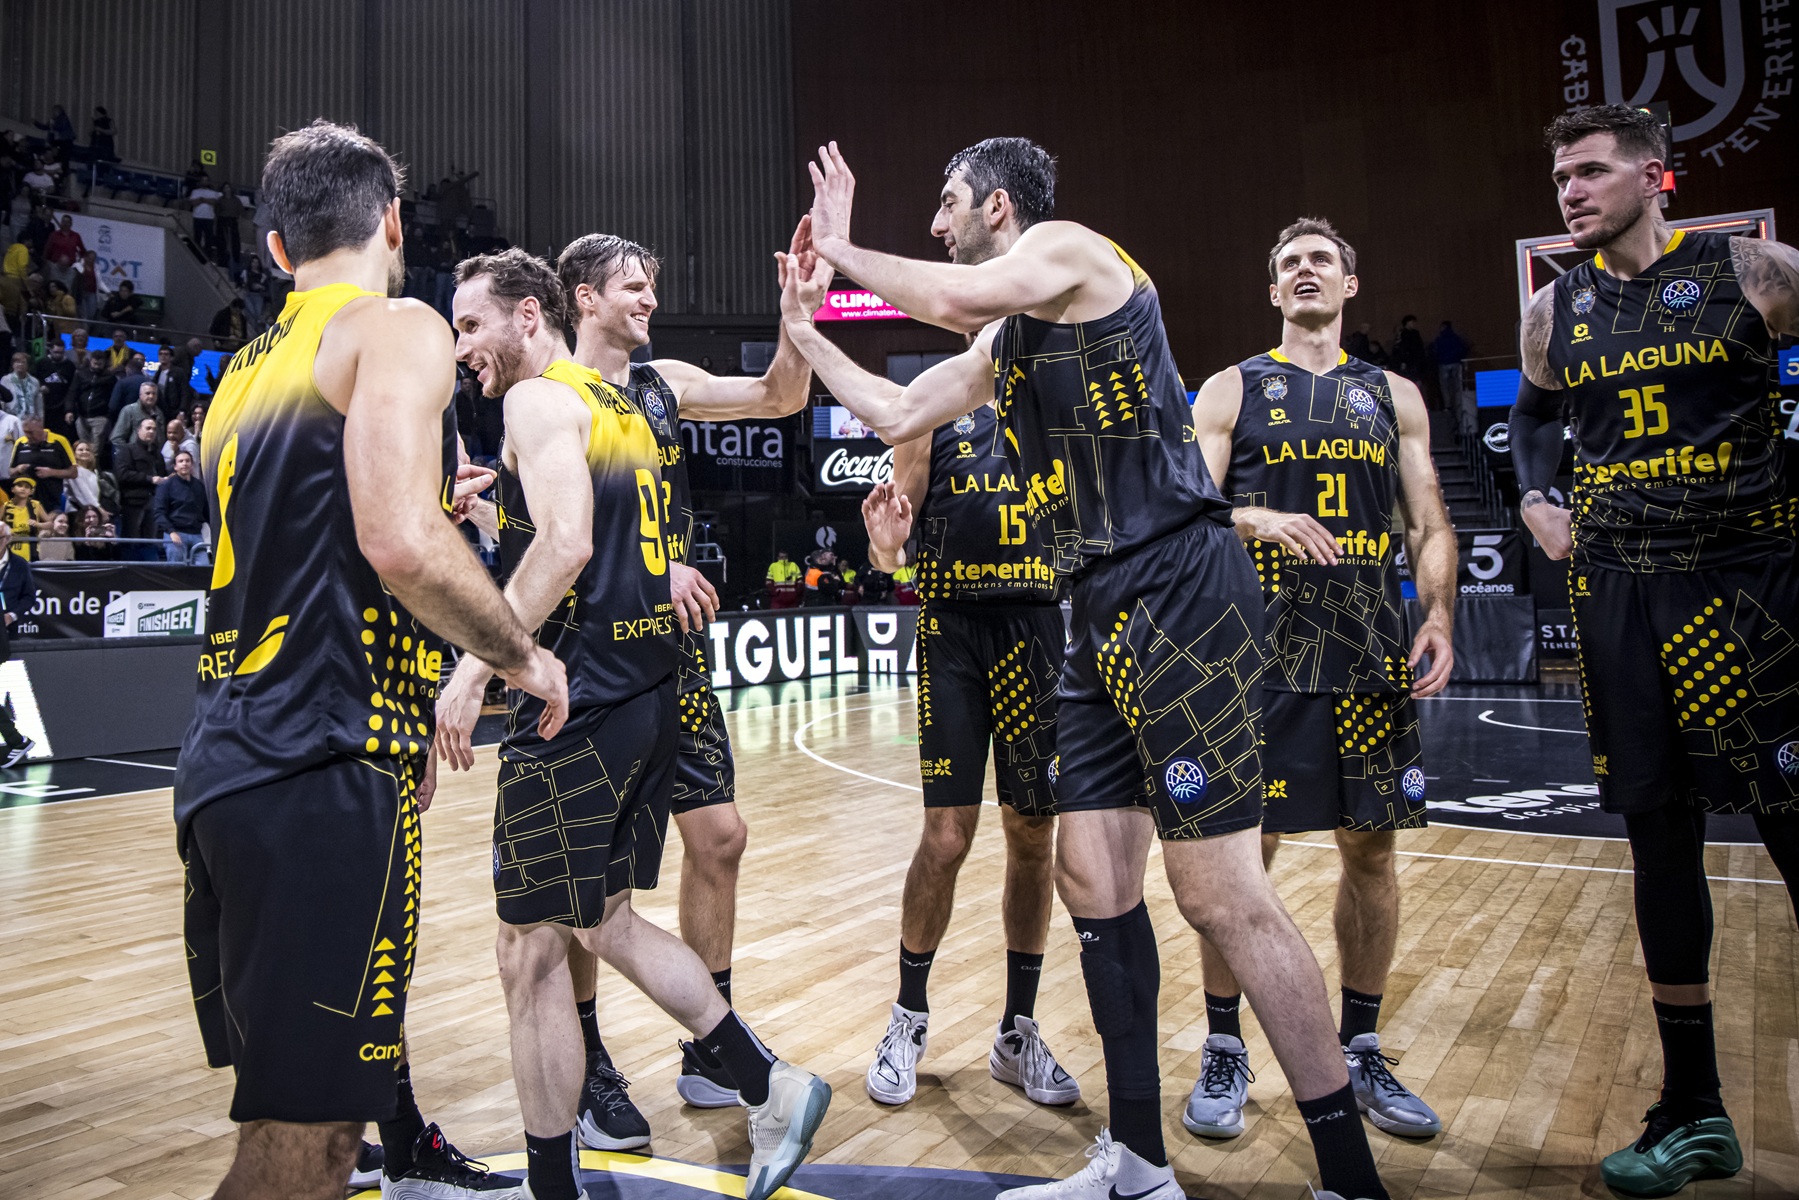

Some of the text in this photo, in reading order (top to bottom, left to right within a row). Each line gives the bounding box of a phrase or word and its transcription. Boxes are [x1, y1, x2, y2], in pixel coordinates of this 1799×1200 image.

[830, 293, 892, 308] CLIMA
[1565, 339, 1729, 388] LA LAGUNA
[1618, 384, 1669, 439] 35
[716, 456, 783, 468] construcciones
[1262, 438, 1386, 467] LA LAGUNA
[950, 474, 980, 494] LA
[1316, 473, 1349, 518] 21
[635, 468, 667, 576] 9
[998, 504, 1027, 546] 15
[1467, 535, 1504, 580] 5
[1460, 581, 1515, 594] océanos
[69, 591, 100, 615] de
[139, 606, 194, 632] FINISHER
